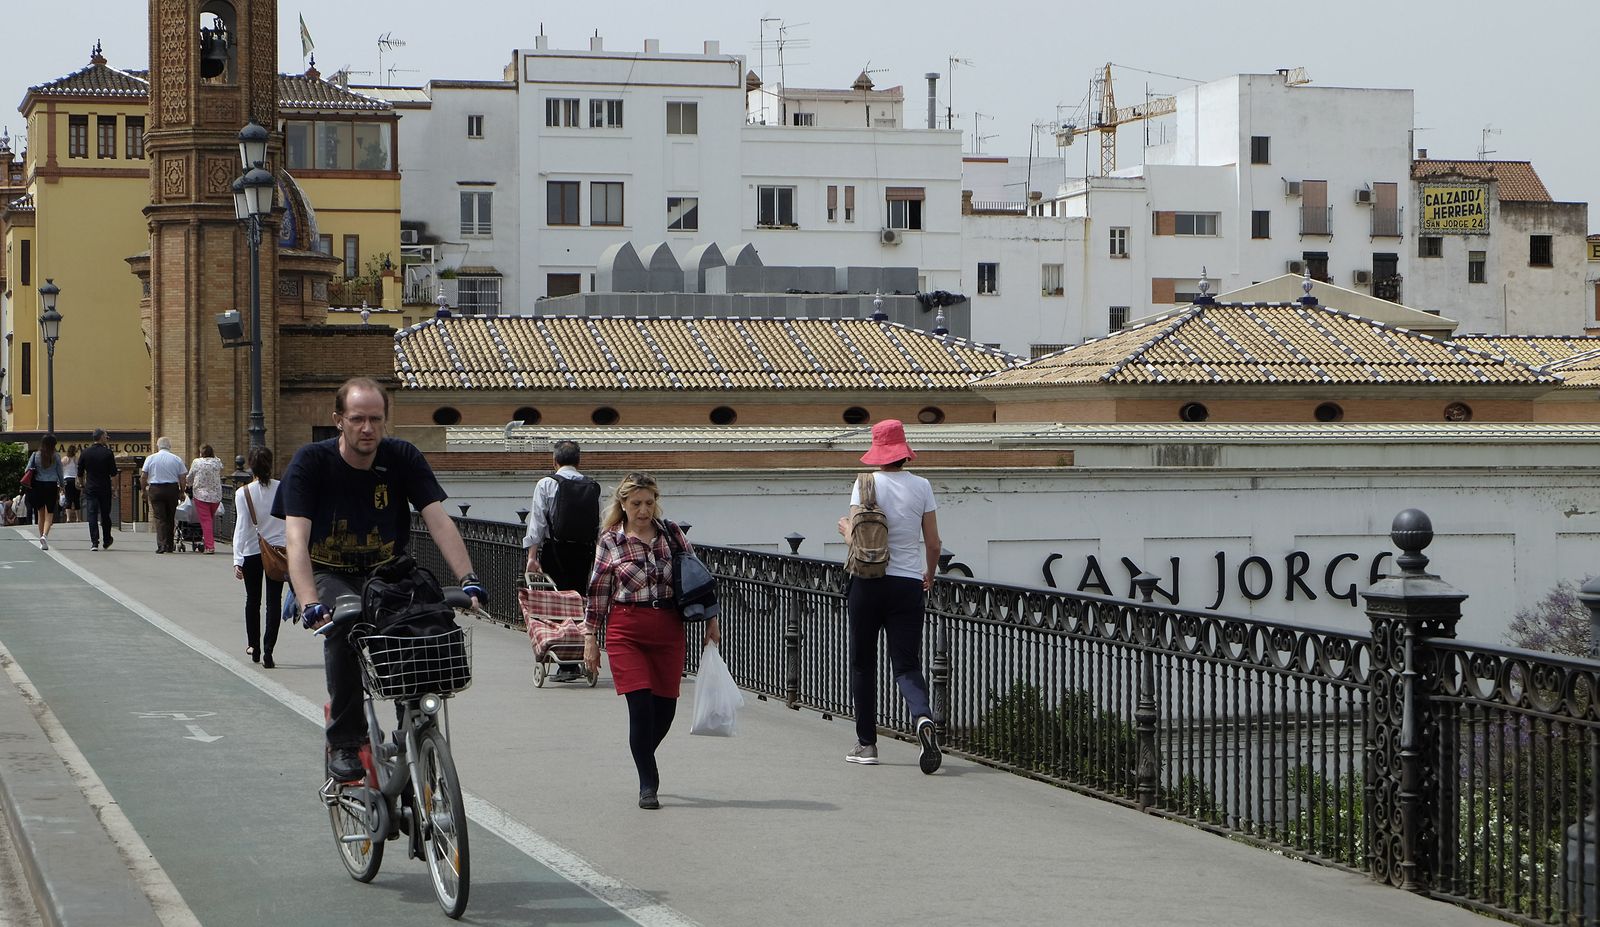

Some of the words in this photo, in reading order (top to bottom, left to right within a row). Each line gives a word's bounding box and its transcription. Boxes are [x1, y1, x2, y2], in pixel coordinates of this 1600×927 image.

[1425, 189, 1482, 206] CALZADOS
[1433, 203, 1483, 219] HERRERA
[1442, 219, 1469, 228] JORGE
[1471, 218, 1484, 228] 24
[1042, 553, 1181, 606] SAN
